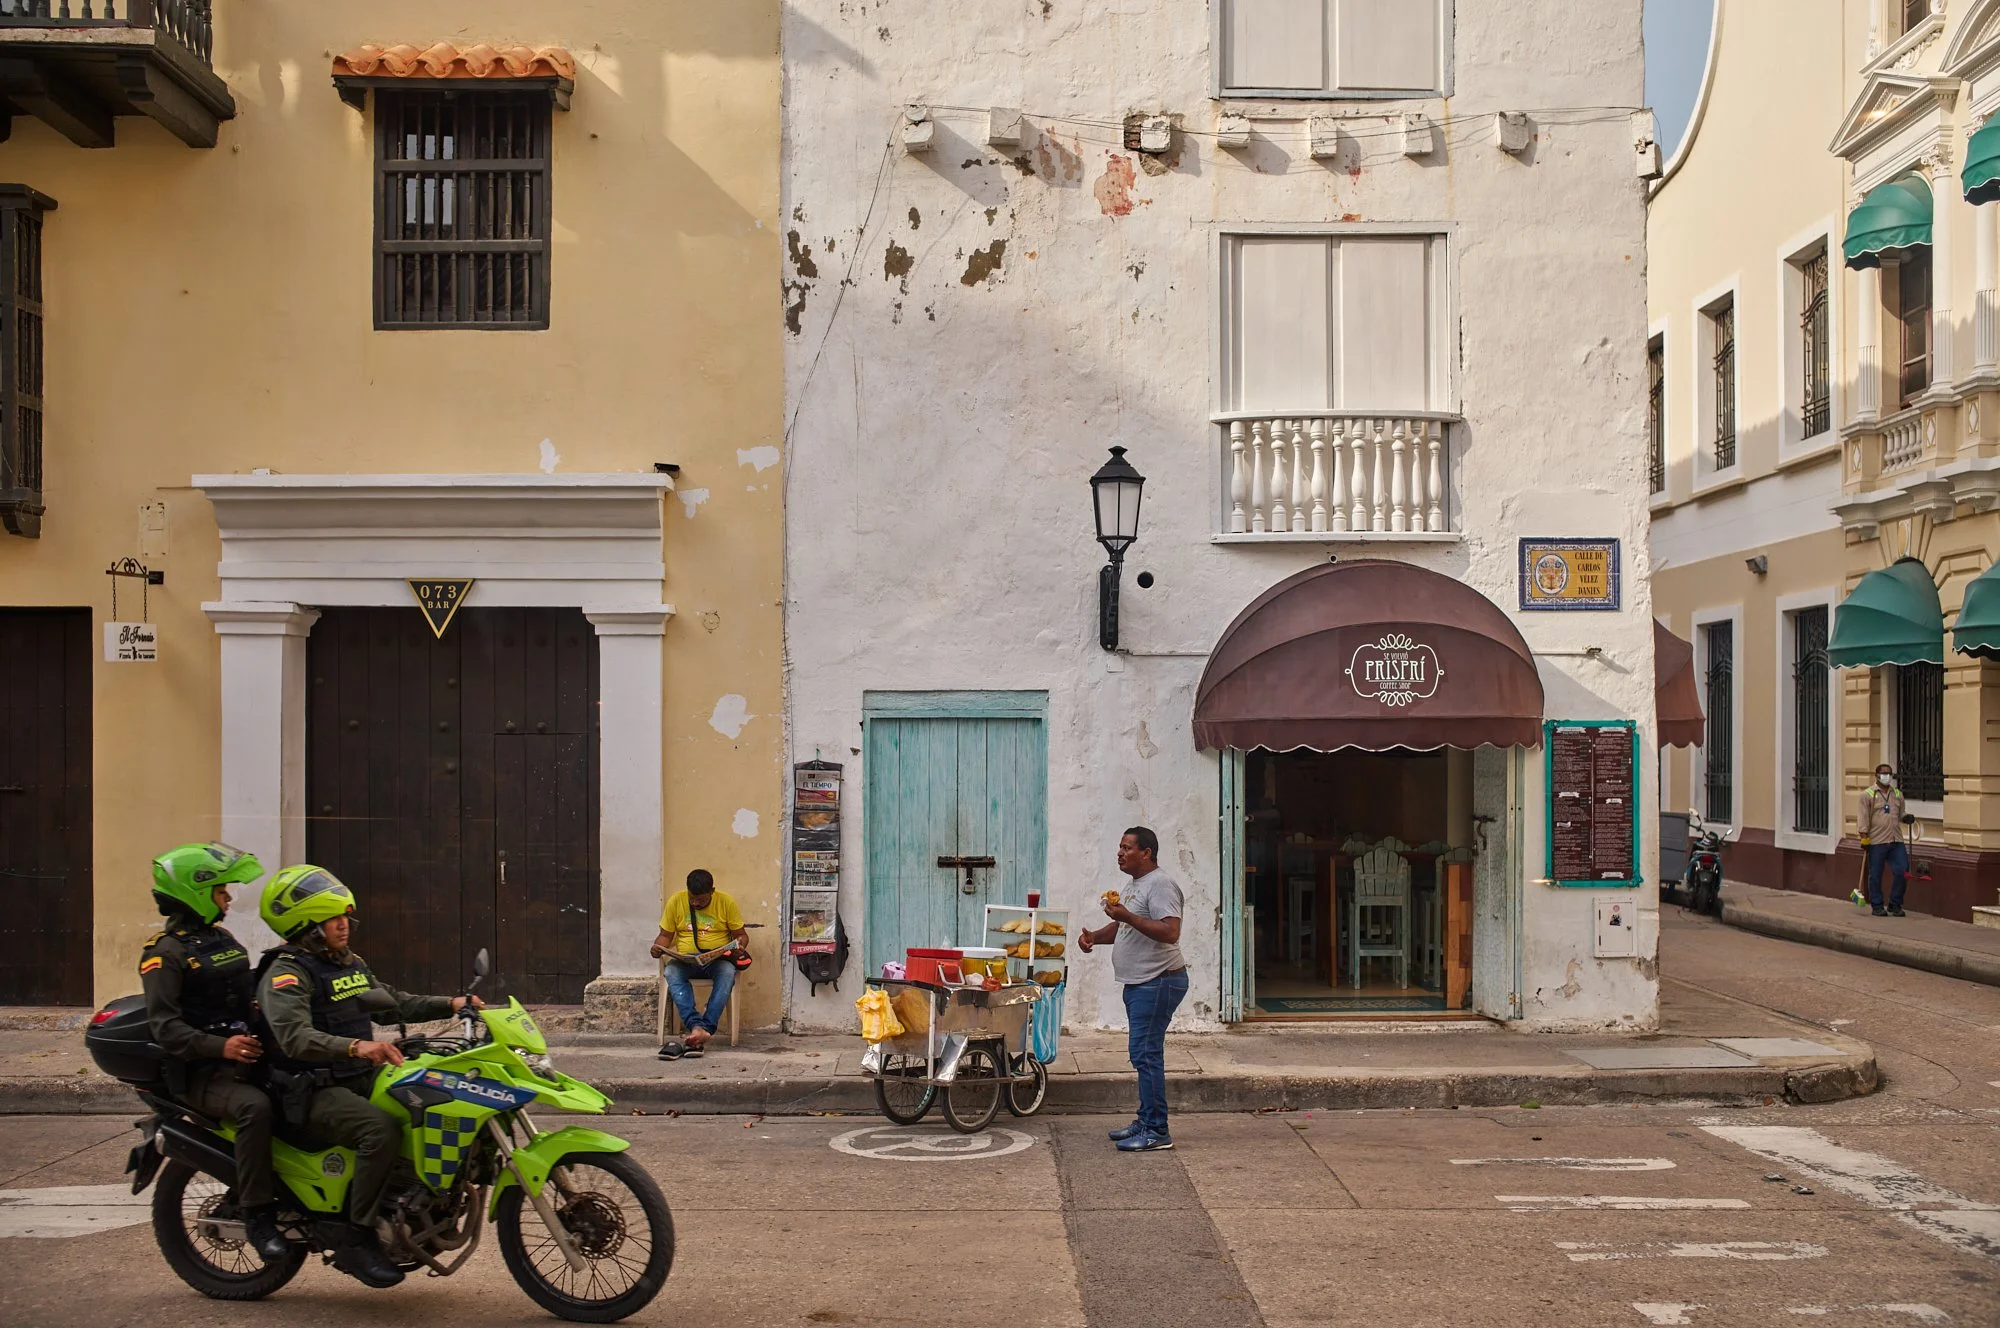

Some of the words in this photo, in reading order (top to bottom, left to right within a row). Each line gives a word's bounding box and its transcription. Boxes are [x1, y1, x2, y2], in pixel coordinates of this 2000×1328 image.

[1574, 551, 1594, 560] CALLE
[1595, 551, 1604, 560] DE
[1577, 563, 1601, 572] CARLOS
[420, 585, 457, 599] 073
[427, 600, 450, 609] BAR
[1365, 655, 1426, 681] PRISPRÍ
[1380, 682, 1398, 690] COFFEE
[1398, 682, 1412, 690] SHOP
[457, 1080, 517, 1104] POLICÍA
